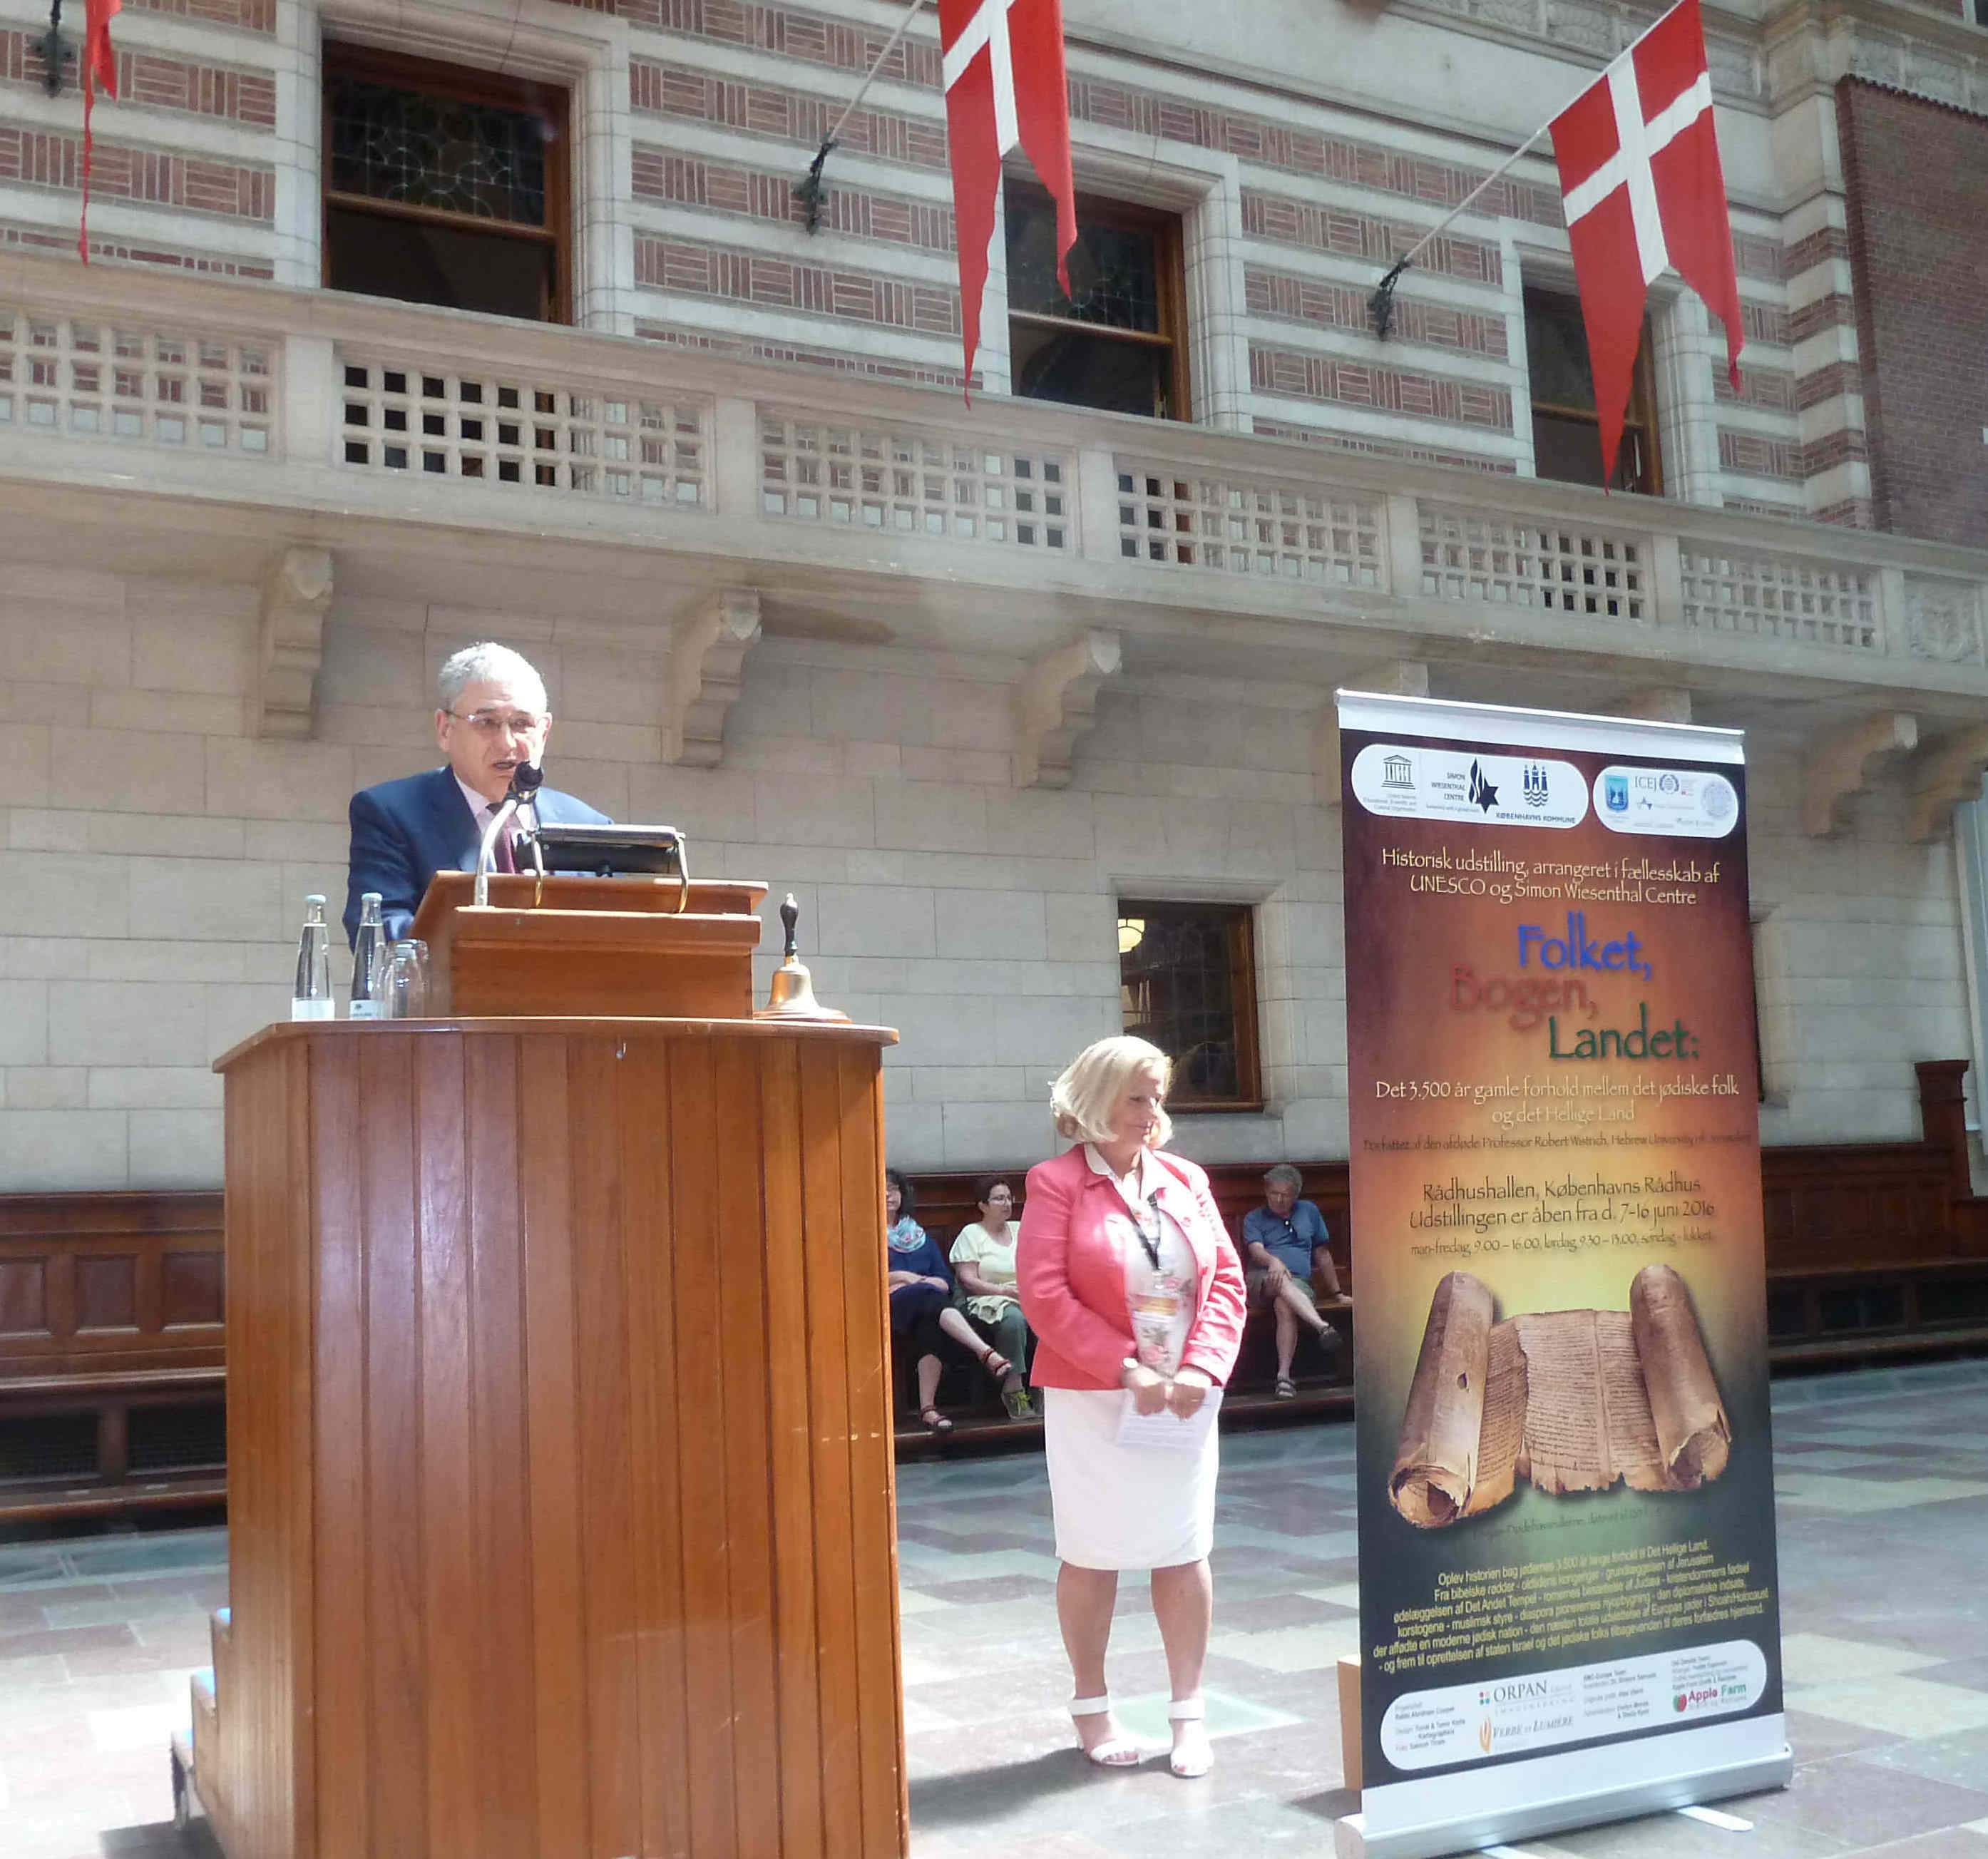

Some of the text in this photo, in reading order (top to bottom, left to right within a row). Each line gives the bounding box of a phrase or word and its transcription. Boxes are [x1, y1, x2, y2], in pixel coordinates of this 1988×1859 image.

[1543, 815, 1576, 824] KOMMUNE
[1382, 846, 1720, 884] Historisk udstilling, arrangeret i fællesskab af
[1410, 874, 1696, 904] UNESCO og Simon Wiesenthal Centre
[1517, 911, 1651, 981] Folket,
[1450, 963, 1598, 1032] Bogen,
[1548, 1002, 1699, 1059] Landet:
[1376, 1074, 1740, 1106] Det 3.500 år gamle forhold mellem det jødiske folk
[1492, 1100, 1634, 1130] og det Hellige Land
[1534, 1132, 1569, 1147] Robert
[1423, 1171, 1701, 1202] Rådhushallen, Københavns Rådhus
[1410, 1203, 1506, 1234] Udstillingen
[1511, 1211, 1528, 1224] er
[1532, 1201, 1571, 1223] åben
[1577, 1199, 1597, 1221] fra
[1650, 1203, 1678, 1231] juni
[1683, 1201, 1714, 1217] 2016
[1438, 1573, 1463, 1587] Oplev
[1466, 1568, 1500, 1582] historien
[1435, 1589, 1450, 1602] Fra
[1451, 1585, 1485, 1600] bibelske
[1455, 1601, 1464, 1614] af
[1465, 1601, 1480, 1614] Det
[1398, 1622, 1445, 1637] korstogene
[1452, 1615, 1491, 1630] muslimsk
[1373, 1644, 1388, 1658] der
[1419, 1639, 1430, 1650] en
[1432, 1634, 1470, 1648] moderne
[1384, 1660, 1395, 1674] og
[1396, 1655, 1415, 1669] frem
[1493, 1680, 1547, 1702] ORPAN
[1689, 1686, 1718, 1704] Apple
[1721, 1684, 1746, 1696] Farm
